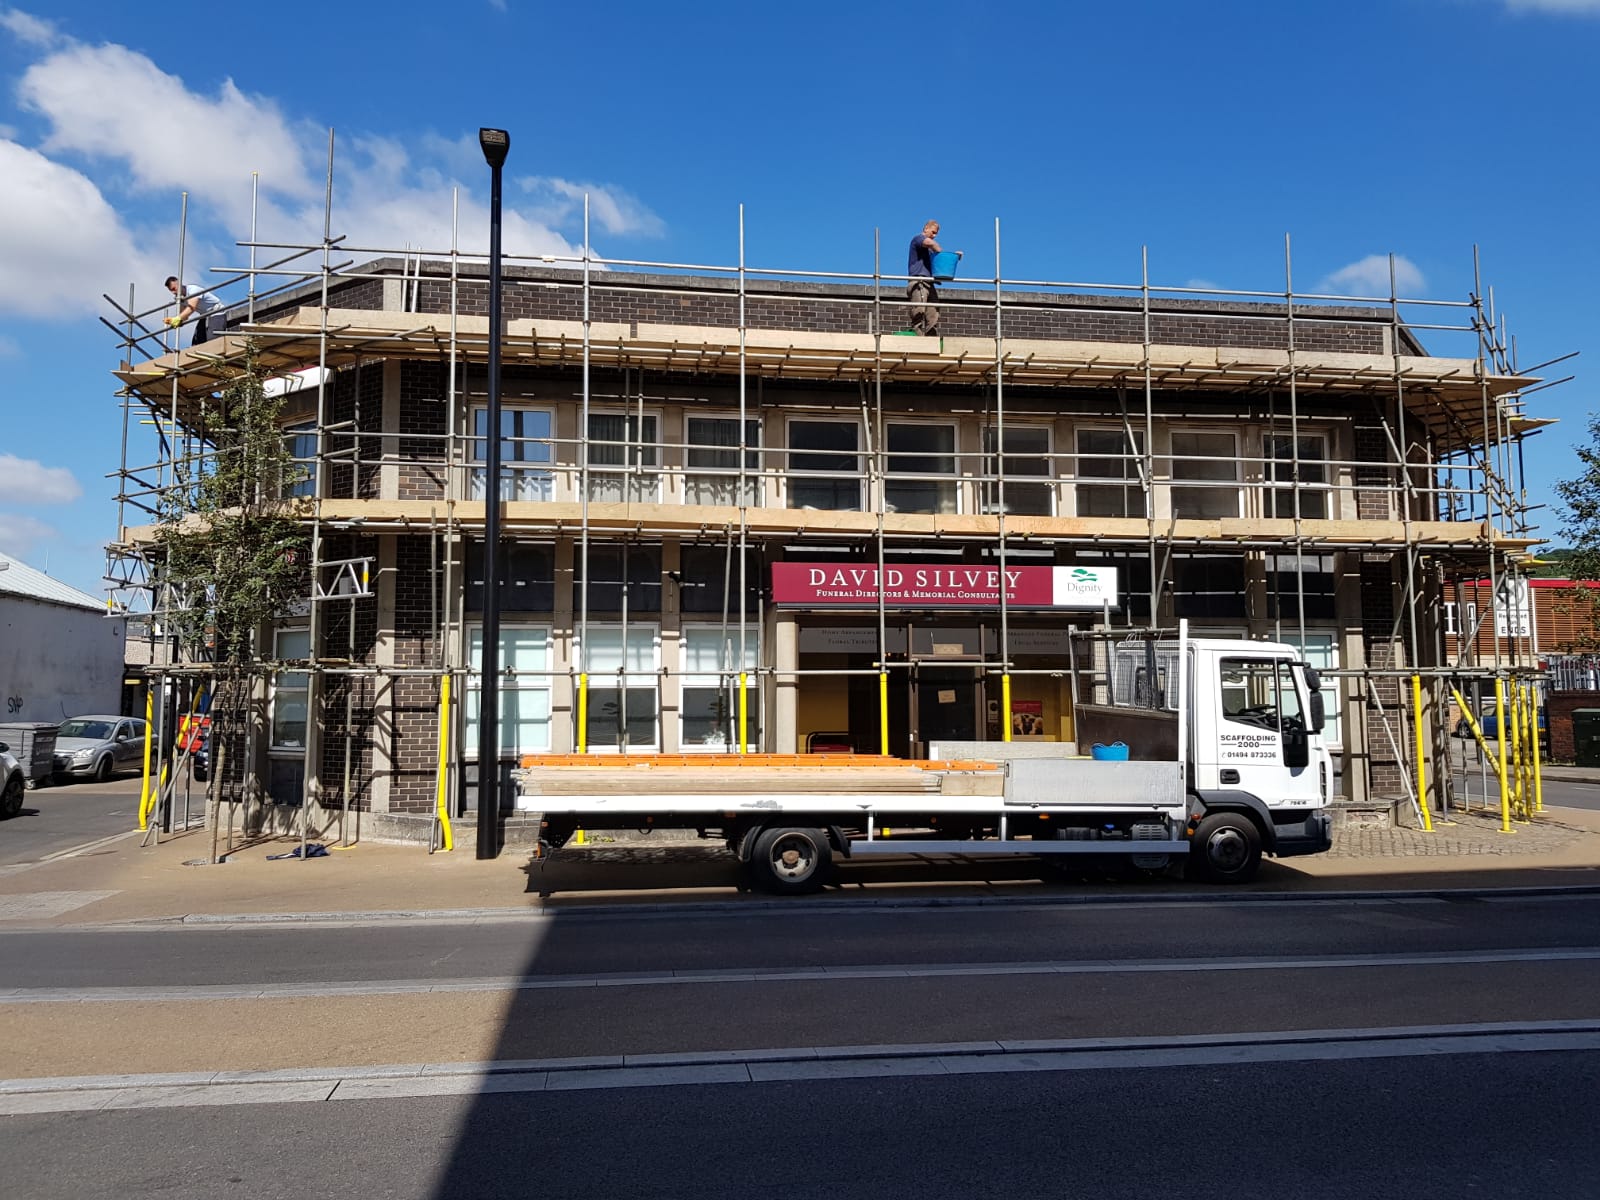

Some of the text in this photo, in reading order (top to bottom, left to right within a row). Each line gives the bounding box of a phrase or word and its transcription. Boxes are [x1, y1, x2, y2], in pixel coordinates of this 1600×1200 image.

[809, 569, 1022, 588] DAVID SILVEY
[1067, 582, 1102, 595] Dignity
[903, 590, 910, 598] &
[957, 590, 1016, 599] CONSULTATS
[160, 624, 189, 633] ENS
[1220, 734, 1277, 742] SCAFFOLDING
